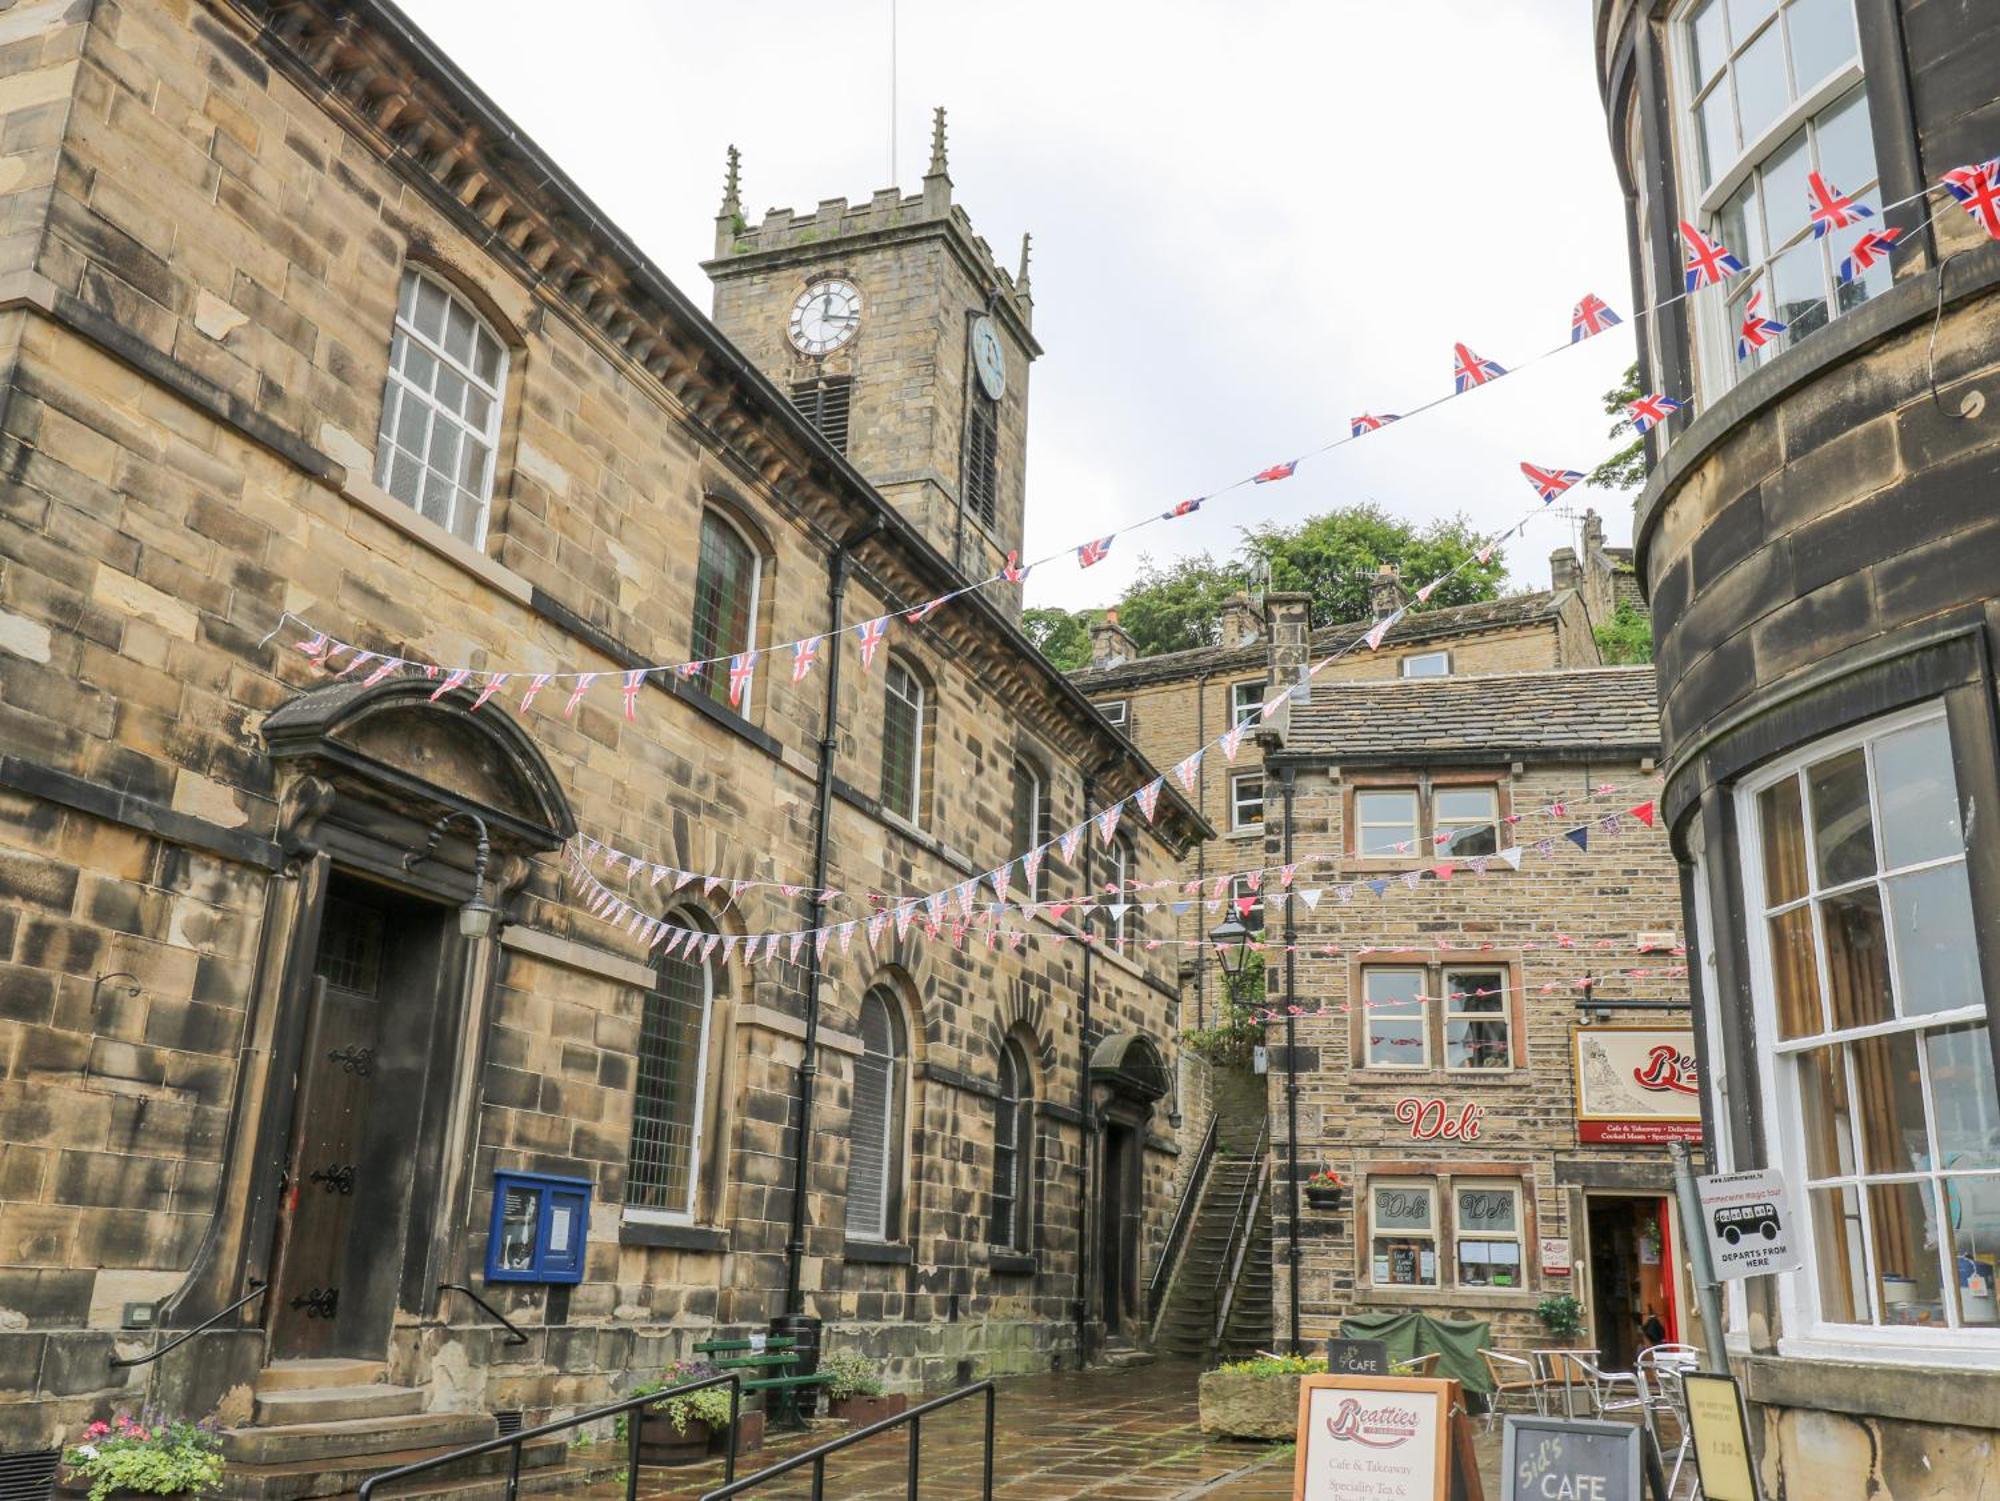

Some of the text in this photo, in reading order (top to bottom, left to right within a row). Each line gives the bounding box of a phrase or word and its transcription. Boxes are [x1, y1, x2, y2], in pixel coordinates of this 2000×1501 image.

[1395, 1097, 1485, 1142] Deli
[1376, 1192, 1427, 1219] Deli
[1459, 1193, 1512, 1219] Deli
[1722, 1246, 1787, 1262] DEPARTS FROM
[1746, 1258, 1770, 1268] HERE
[1348, 1359, 1377, 1371] CAFE
[1327, 1398, 1420, 1447] Beatties
[1328, 1458, 1411, 1475] Cafe & Takeaway
[1376, 1482, 1393, 1494] Tea
[1395, 1485, 1407, 1496] &
[1541, 1472, 1606, 1501] CAFE
